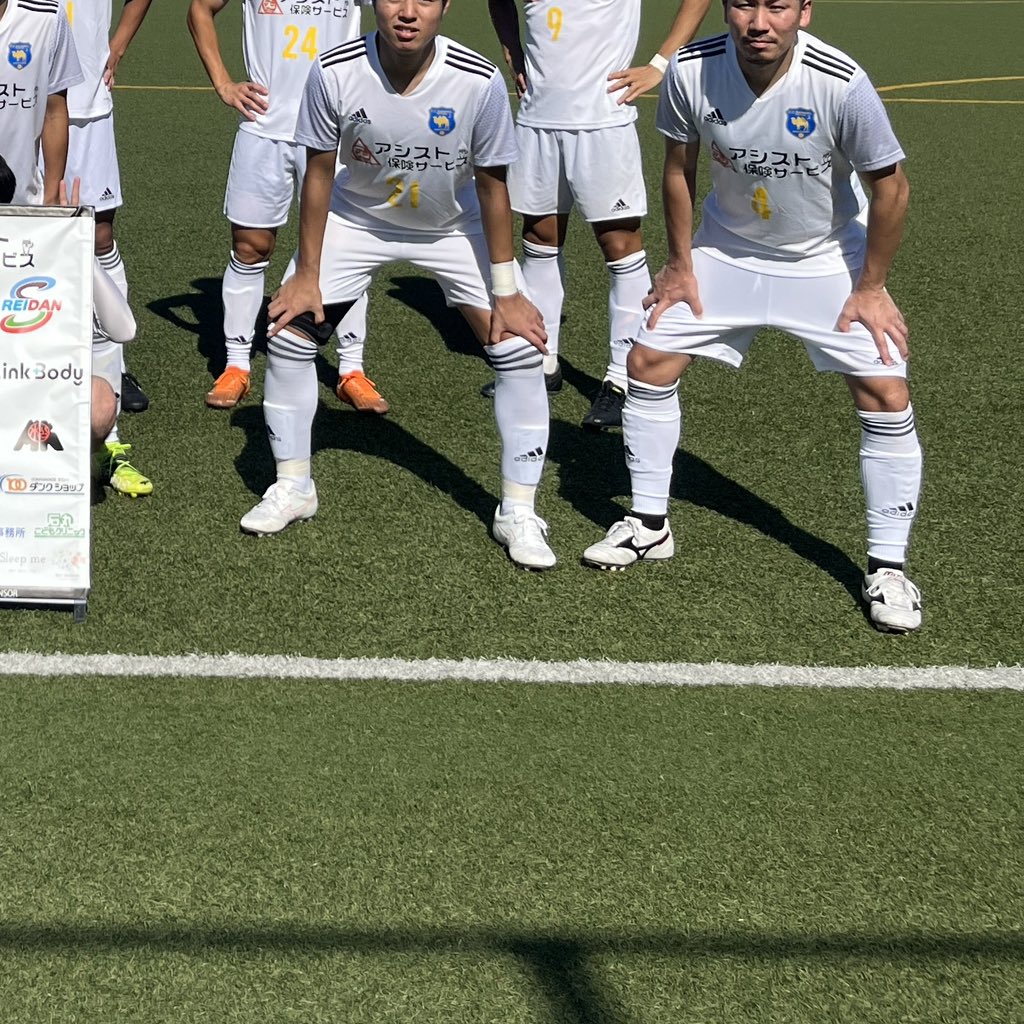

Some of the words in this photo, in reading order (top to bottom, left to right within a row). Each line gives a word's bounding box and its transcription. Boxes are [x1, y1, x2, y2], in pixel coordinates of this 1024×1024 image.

[547, 6, 564, 42] 9
[281, 24, 318, 61] 24
[348, 116, 372, 125] adidas
[704, 115, 728, 127] adidas
[374, 142, 450, 160] アシスト
[729, 147, 811, 167] アシスト
[388, 157, 468, 172] 保険サービス
[744, 161, 832, 179] 保険サービス
[386, 176, 421, 208] 21
[1, 299, 62, 312] REIDAN
[0, 552, 27, 566] Sleep
[30, 555, 47, 564] me
